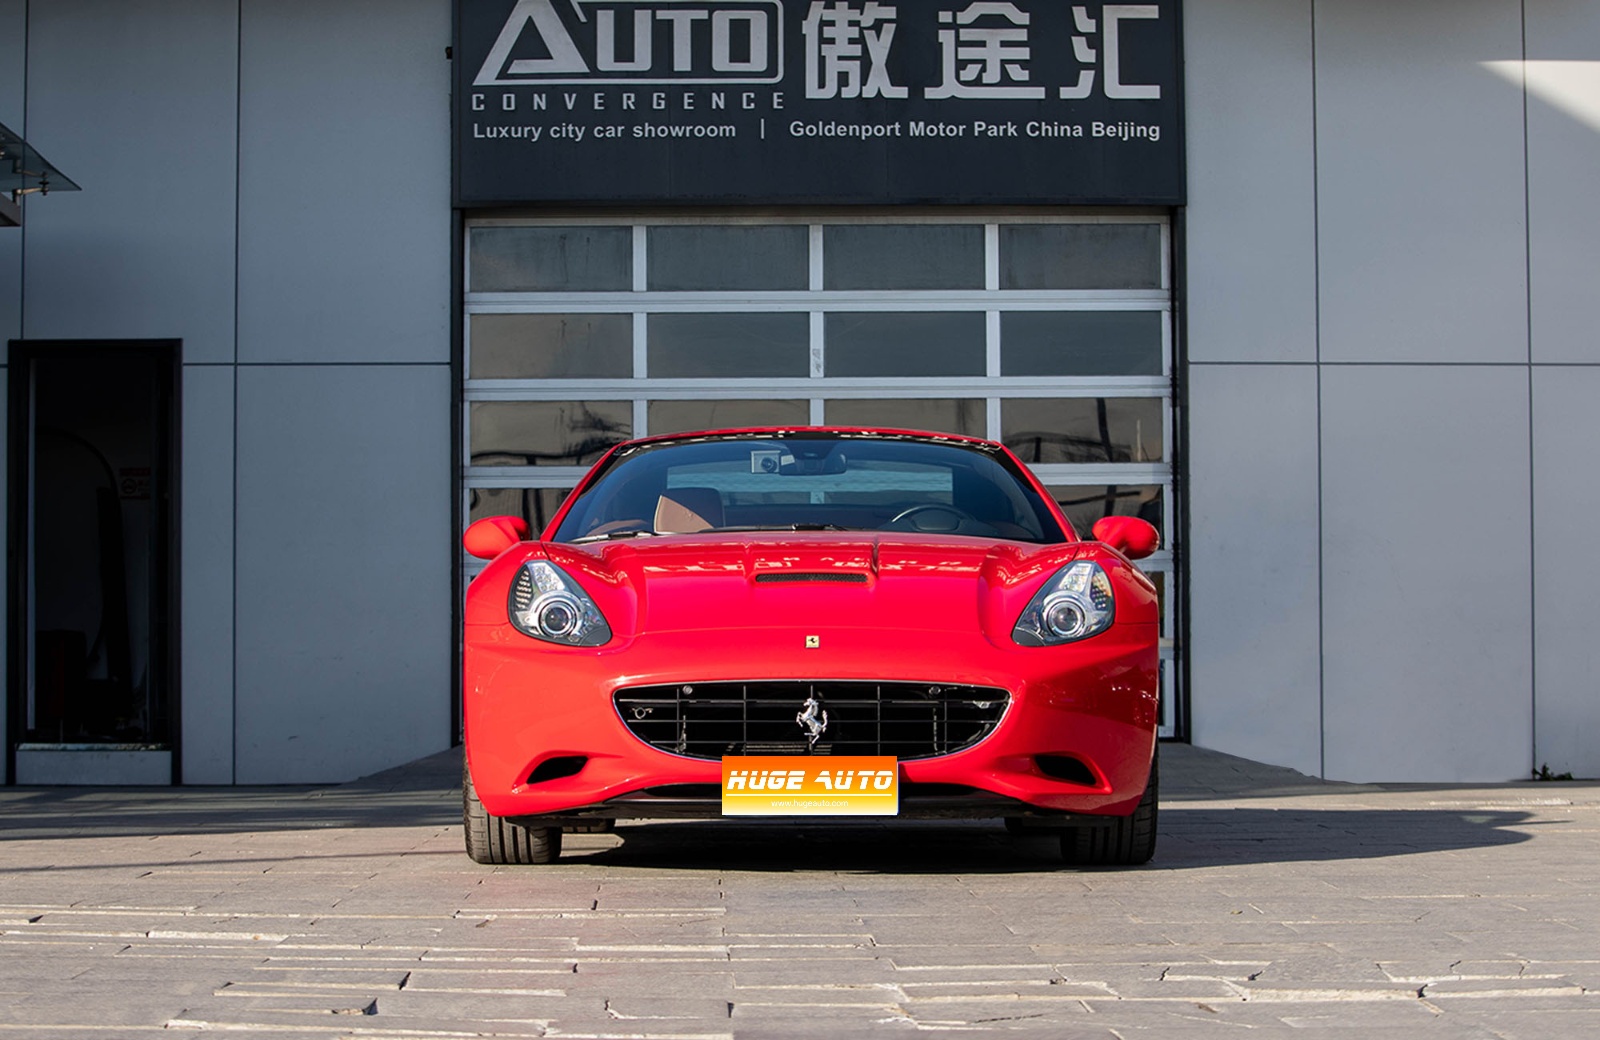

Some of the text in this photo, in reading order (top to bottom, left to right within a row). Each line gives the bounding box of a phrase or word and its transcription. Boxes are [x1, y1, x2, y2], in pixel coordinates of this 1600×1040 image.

[472, 0, 768, 86] AUTO
[802, 1, 1161, 99] 傲途汇
[471, 92, 784, 111] CONVERGENCE
[473, 122, 736, 142] Luxury city car showroom
[789, 120, 1160, 142] Goldenport Motor Park China Beijing
